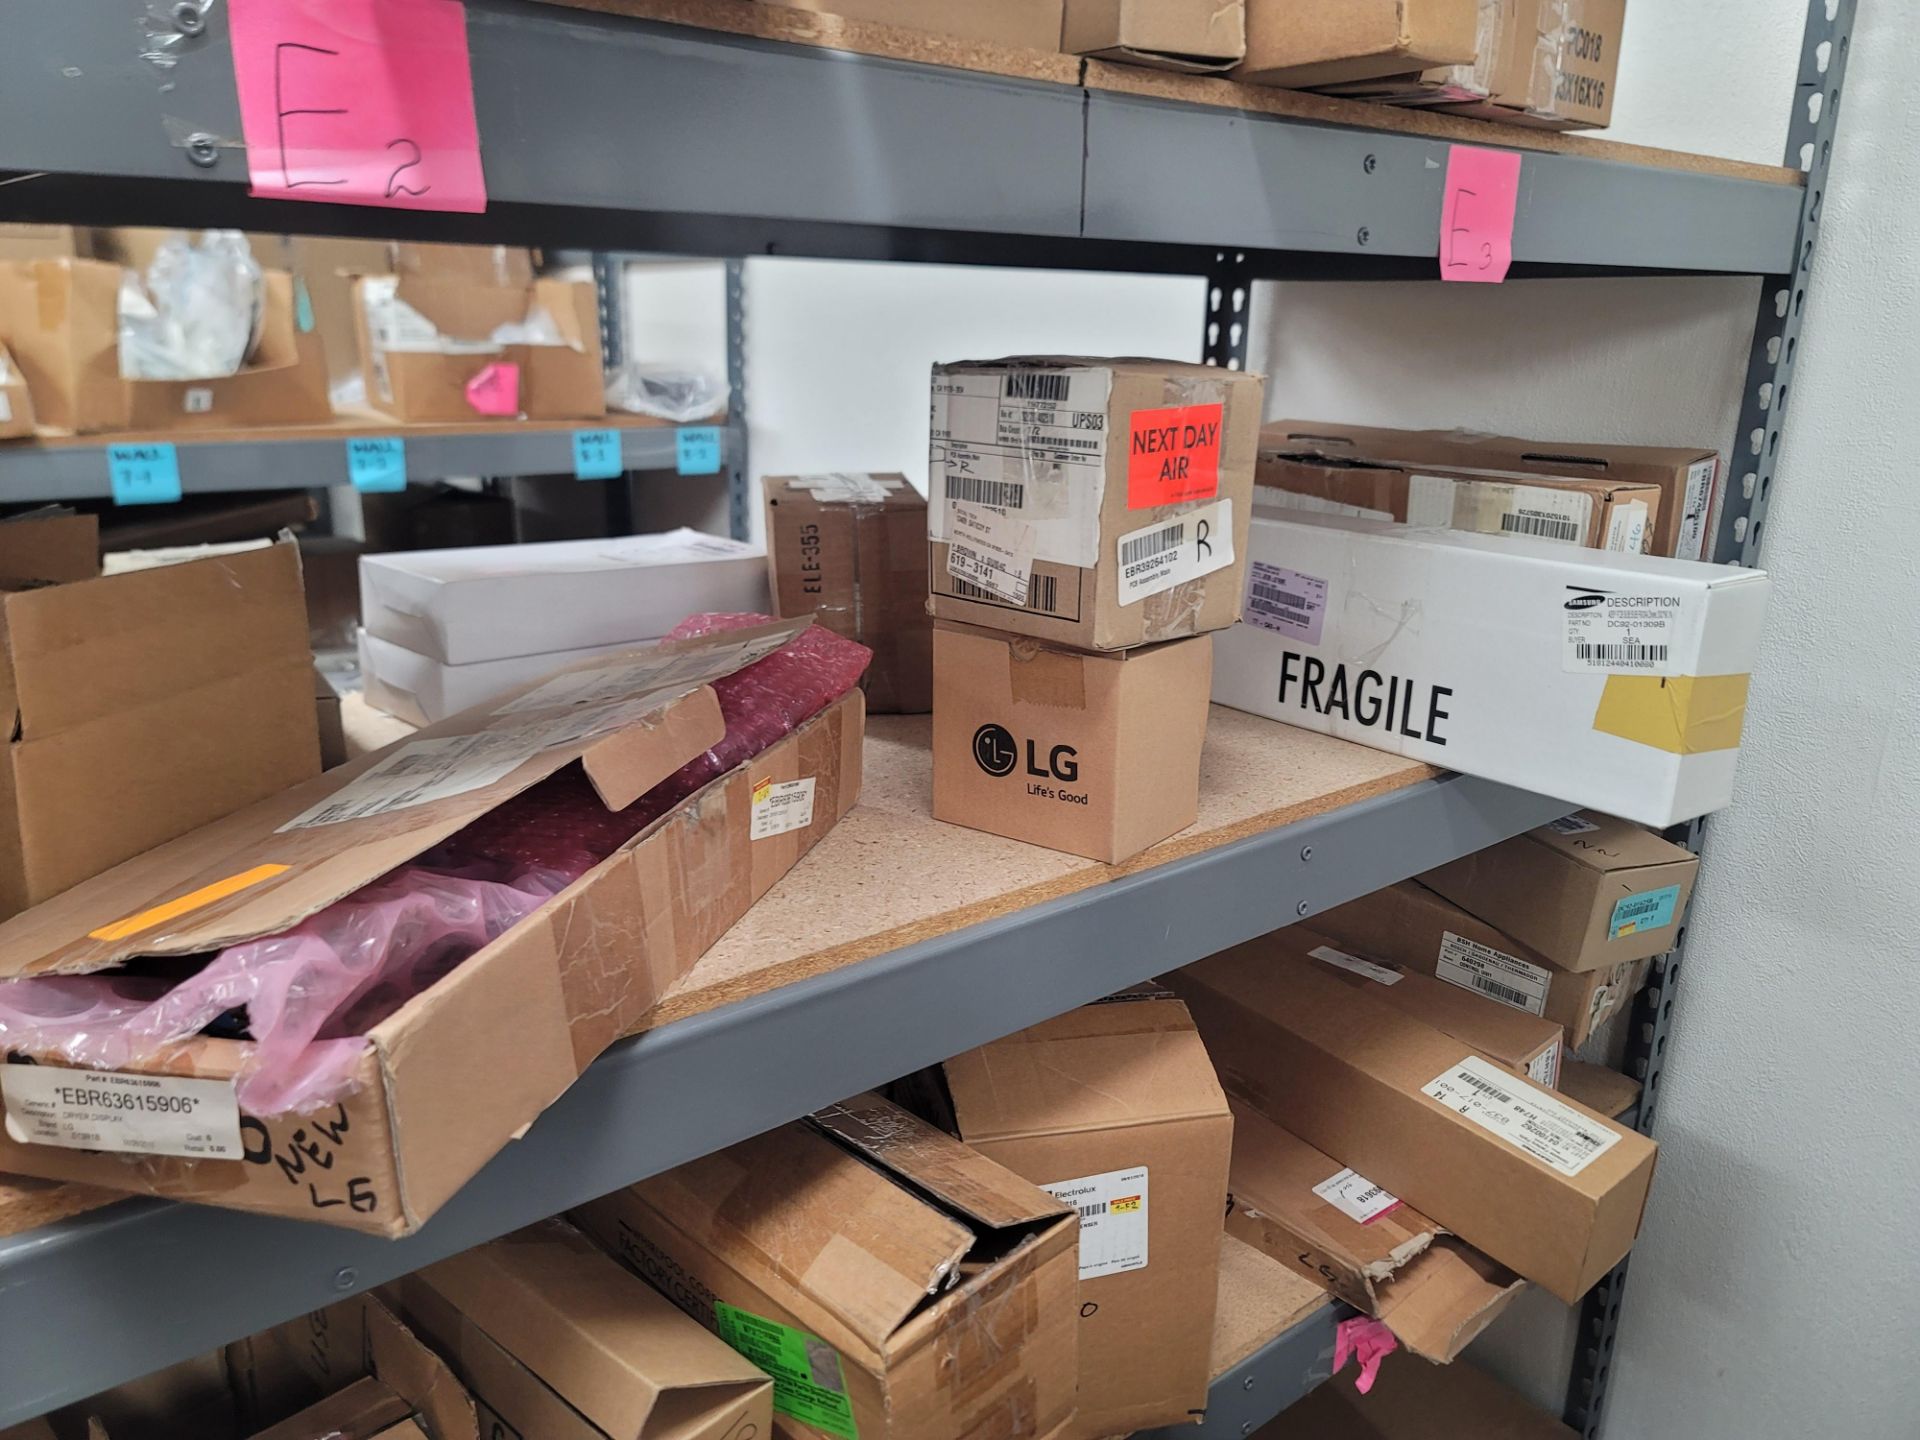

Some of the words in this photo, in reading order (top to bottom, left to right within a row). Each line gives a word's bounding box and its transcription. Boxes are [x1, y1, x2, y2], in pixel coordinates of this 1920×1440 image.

[1071, 413, 1104, 431] UPS03
[1133, 426, 1180, 455] NEXT
[1183, 422, 1219, 449] DAY
[1159, 456, 1190, 482] AIR
[1196, 518, 1213, 563] R
[1607, 597, 1680, 608] DESCRIPTION
[1622, 636, 1640, 644] SEA
[1278, 651, 1454, 746] FRAGILE
[1026, 739, 1078, 782] LG
[1027, 783, 1054, 799] Life's
[1058, 789, 1089, 805] Good
[1493, 951, 1529, 970] Appliances
[275, 1102, 349, 1184] NEW
[1054, 1185, 1097, 1200] Electrolux
